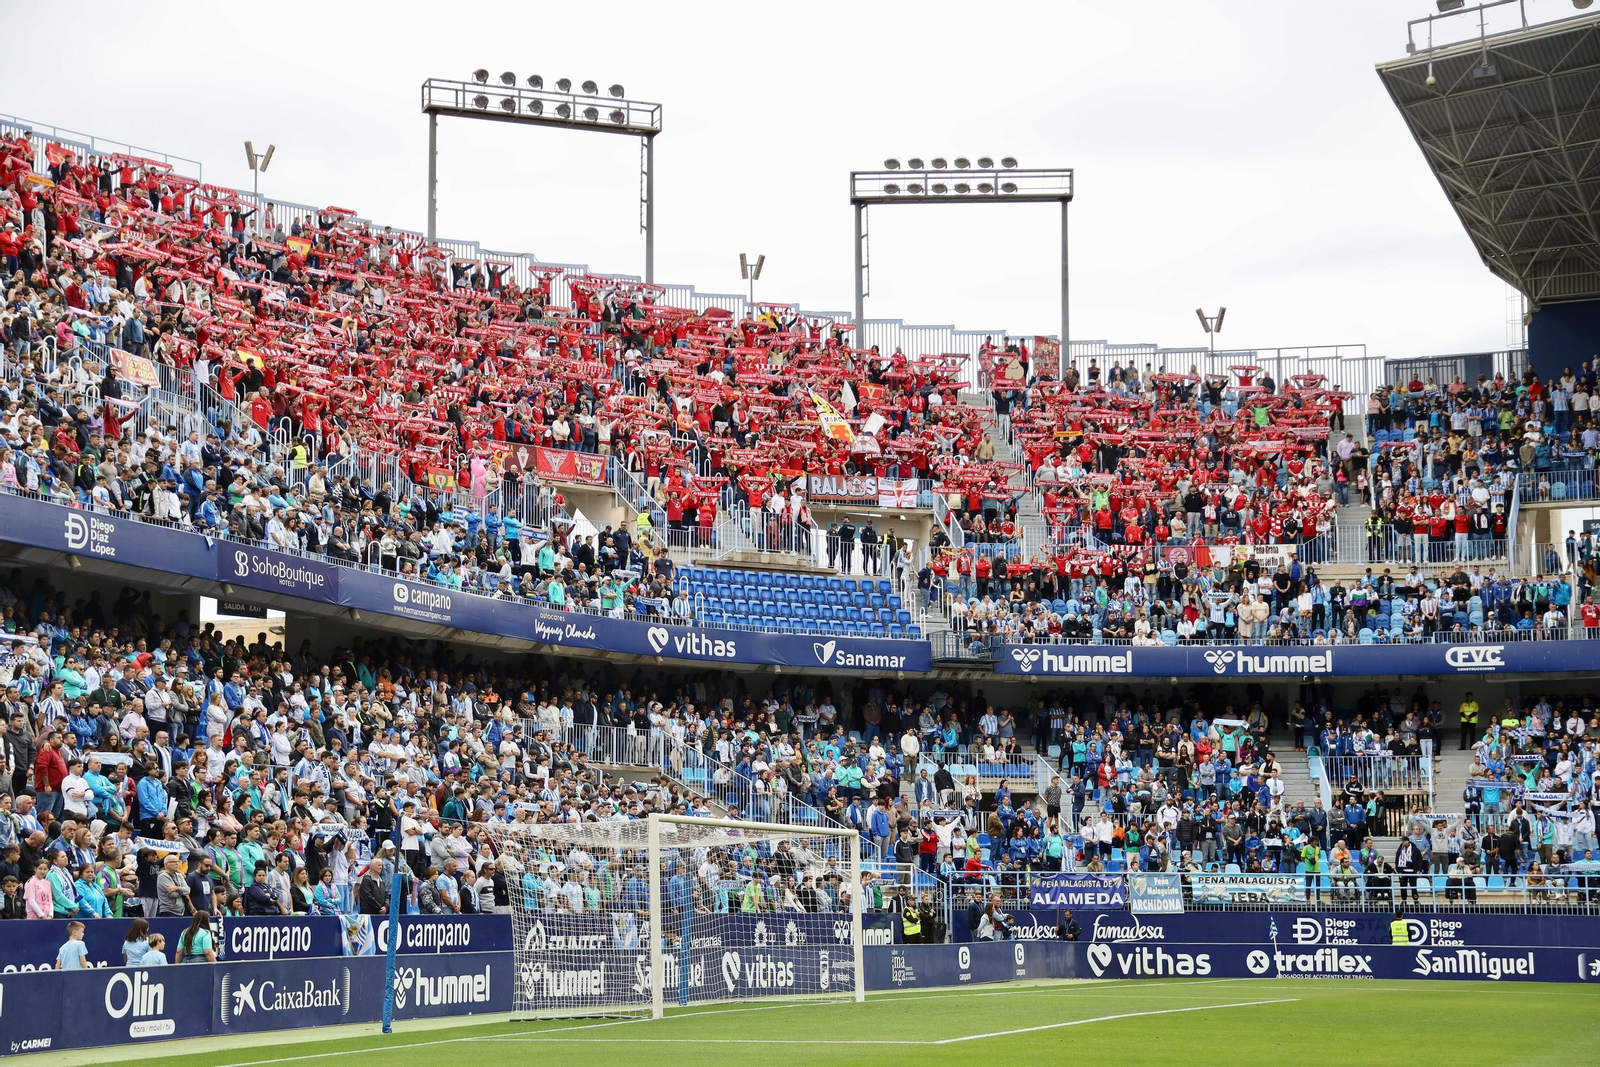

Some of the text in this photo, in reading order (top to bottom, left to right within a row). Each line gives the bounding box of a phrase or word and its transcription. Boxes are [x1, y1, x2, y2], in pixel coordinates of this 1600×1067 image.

[91, 518, 114, 534] Diego
[91, 529, 109, 543] Díaz
[91, 541, 116, 556] López
[252, 556, 324, 590] SohoBoutique
[279, 579, 295, 587] HOTELS
[224, 602, 246, 611] SALIDA
[412, 588, 451, 611] campano
[540, 612, 566, 622] autocares
[565, 623, 596, 640] Olmedo
[674, 632, 736, 658] vithas
[836, 650, 906, 668] Sanamar
[1042, 649, 1132, 672] hummel
[1237, 650, 1332, 673] hummel
[1060, 879, 1101, 888] MALAGUISTA
[1103, 879, 1114, 888] DE
[1154, 877, 1169, 886] Peña
[1228, 876, 1297, 885] MALAGUISTA
[1032, 893, 1124, 905] ALAMEDA
[1132, 899, 1182, 911] ARCHIDONA
[1228, 892, 1270, 903] TEBA
[1092, 914, 1165, 943] famadesa
[1325, 918, 1356, 928] Diego
[1430, 919, 1462, 929] Diego
[407, 923, 470, 954] campano
[1325, 927, 1349, 936] Díaz
[1430, 929, 1455, 938] Díaz
[232, 926, 311, 960] campano
[1326, 936, 1358, 945] López
[1431, 938, 1464, 946] López
[1117, 946, 1212, 975] vithas
[1274, 948, 1372, 973] trafilex
[1412, 949, 1534, 980] SanMiguel
[543, 961, 604, 997] hummel
[632, 954, 704, 994] SaMiuel
[745, 954, 794, 988] vithas
[416, 964, 490, 1006] hummel
[105, 971, 164, 1019] Olin
[259, 978, 341, 1011] CaixaBank
[133, 1024, 145, 1034] fibra
[11, 1042, 20, 1053] by
